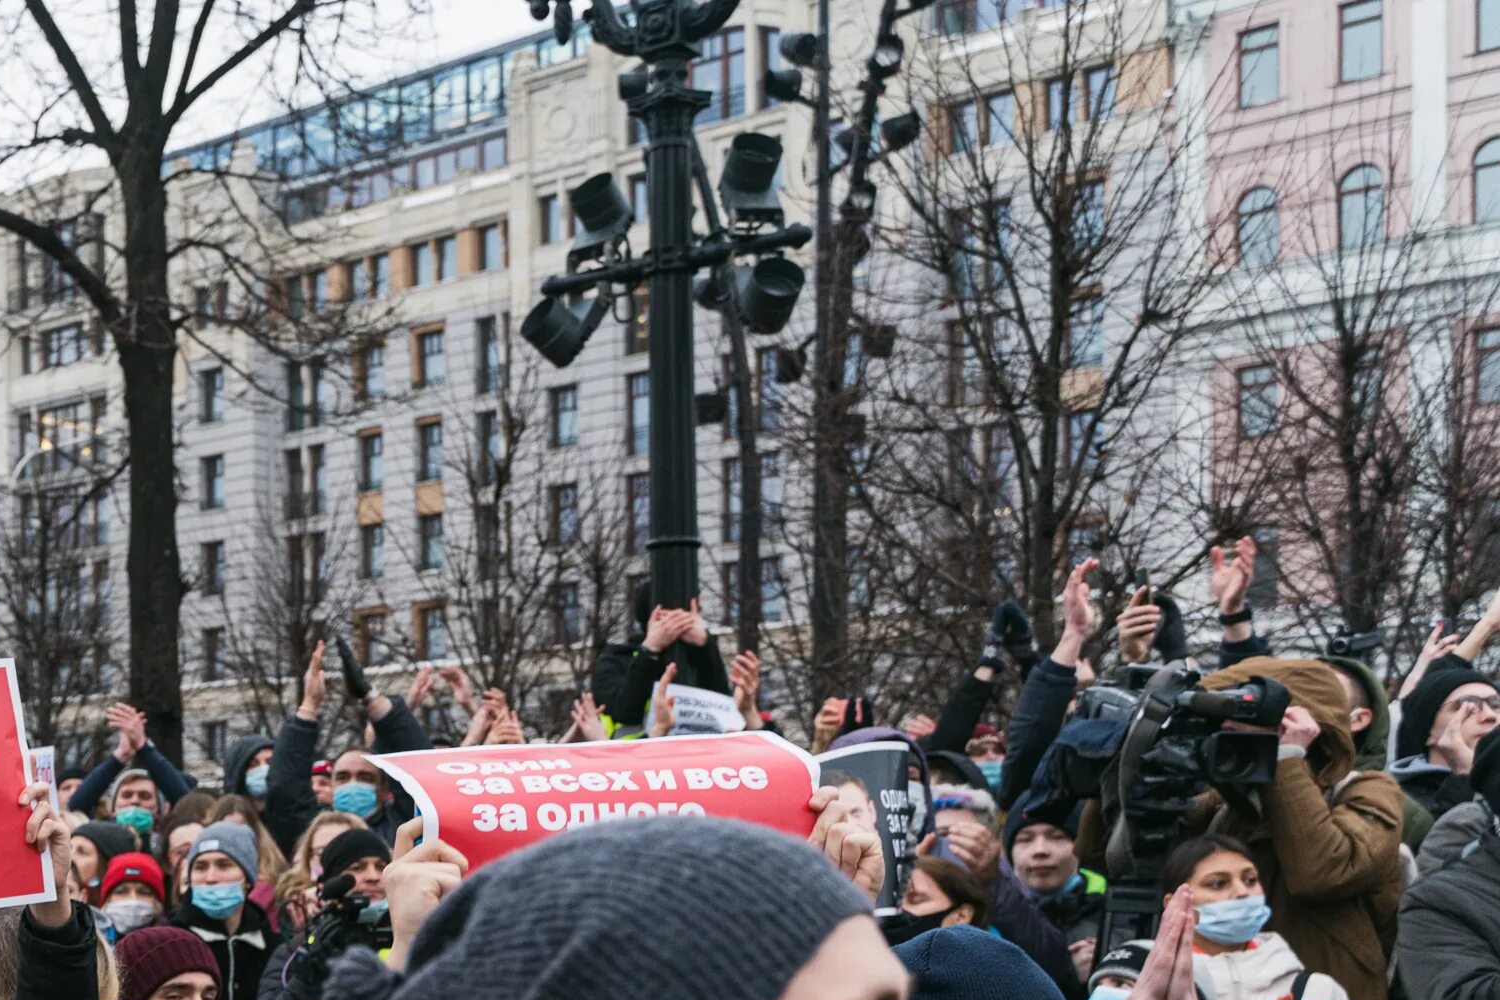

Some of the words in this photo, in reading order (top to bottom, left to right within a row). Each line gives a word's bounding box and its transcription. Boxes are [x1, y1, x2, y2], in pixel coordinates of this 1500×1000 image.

[436, 758, 572, 776] Один
[456, 775, 515, 796] за
[521, 771, 641, 794] всех
[643, 768, 677, 791] и
[683, 765, 769, 791] все
[471, 802, 528, 833] за
